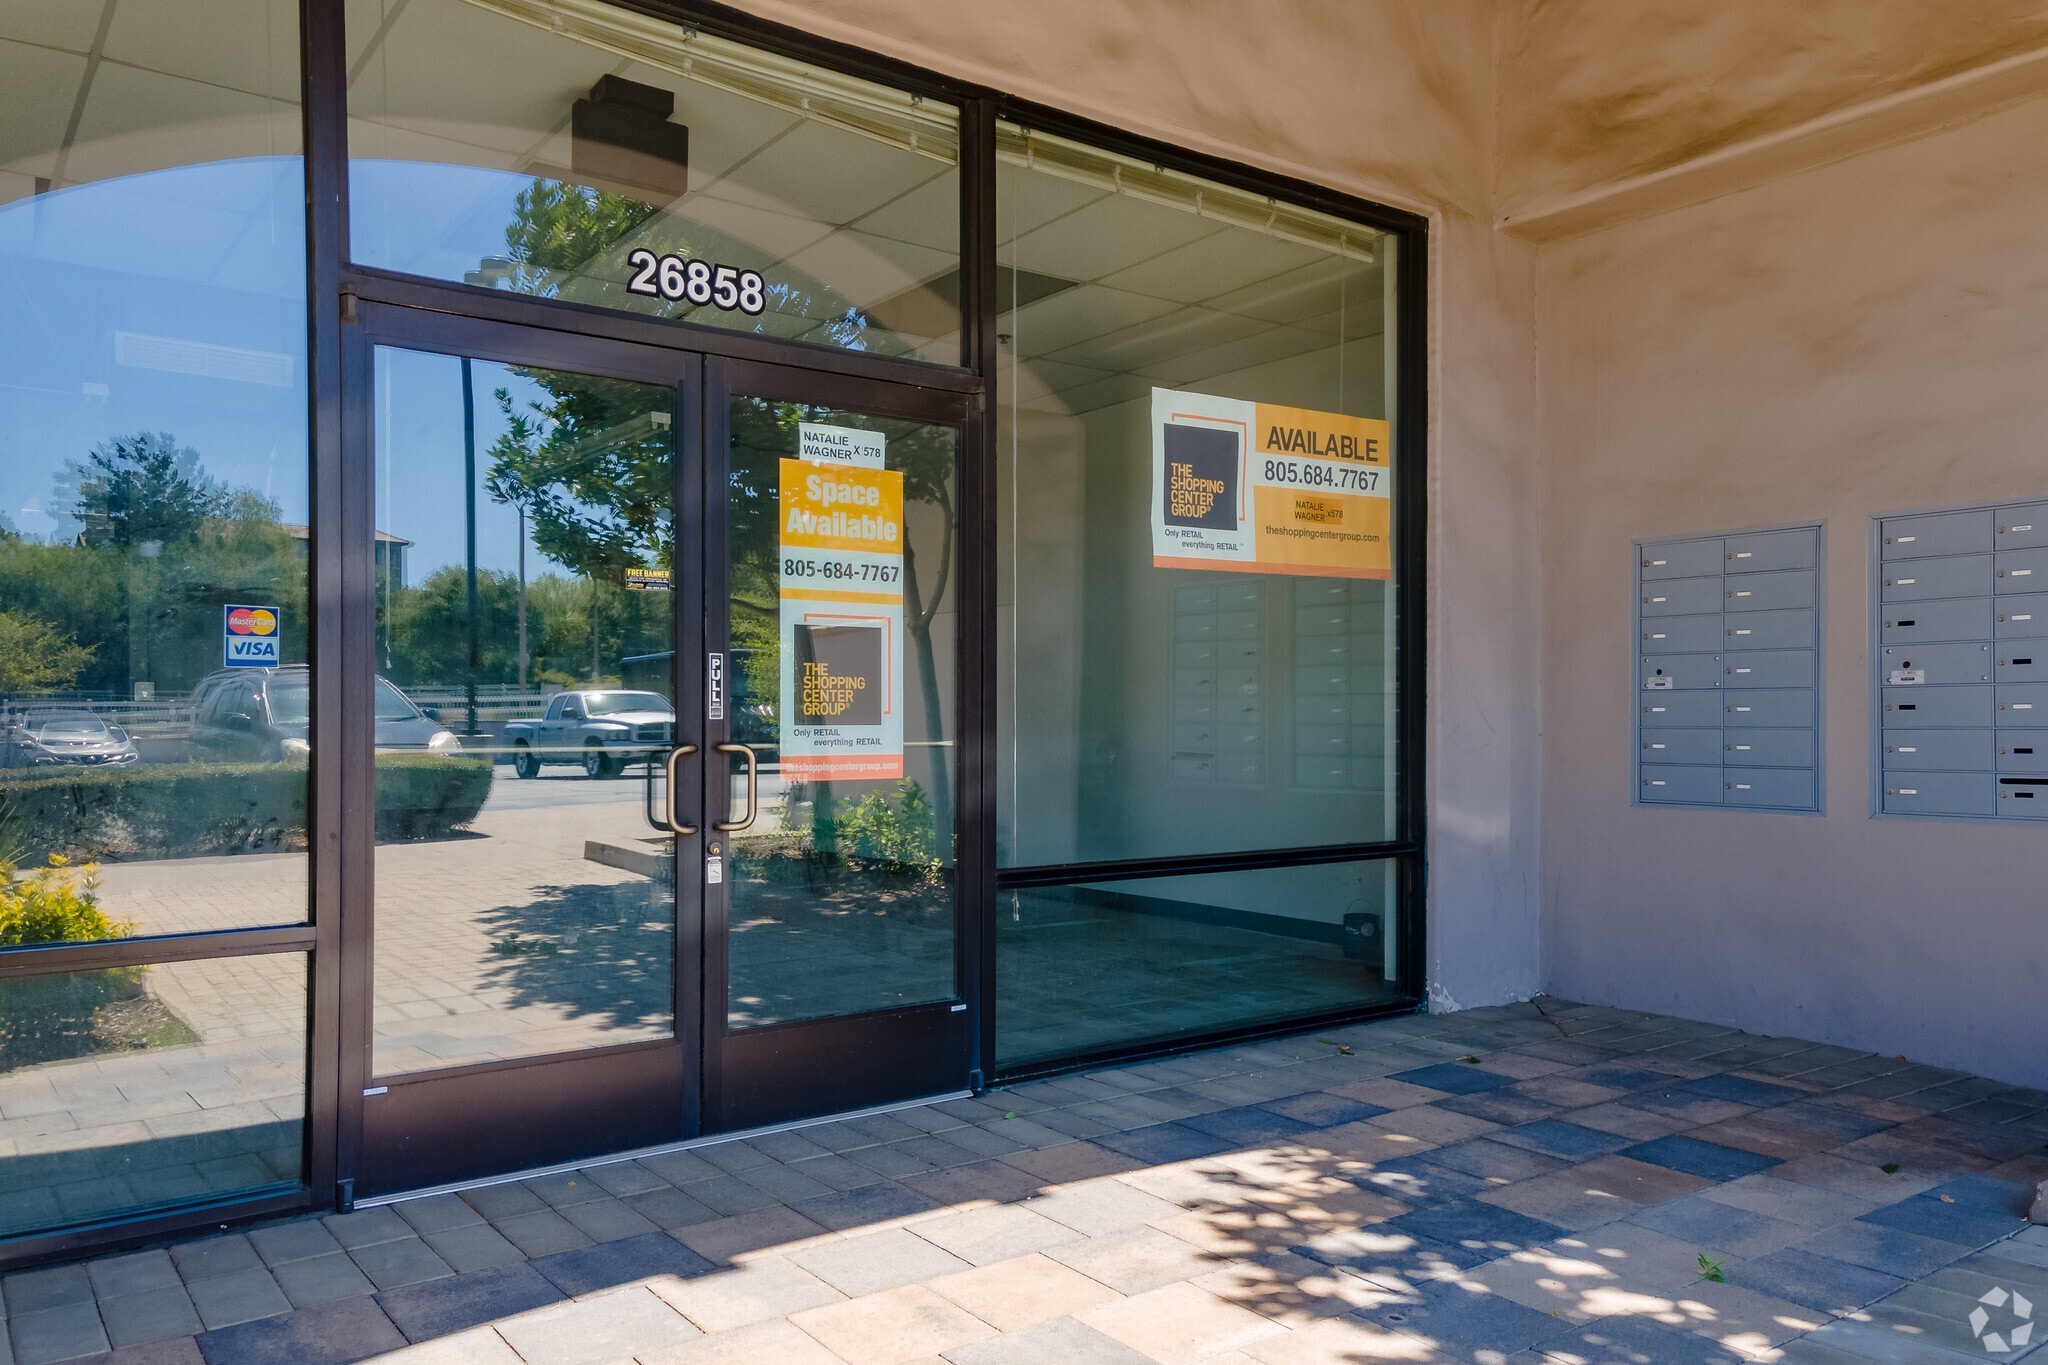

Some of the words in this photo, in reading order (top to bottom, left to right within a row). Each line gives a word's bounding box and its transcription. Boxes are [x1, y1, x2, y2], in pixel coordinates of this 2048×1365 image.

[627, 248, 766, 316] 26858
[803, 431, 849, 446] NATALIE
[1266, 426, 1379, 462] AVAILABLE
[803, 445, 852, 460] WAGNER
[853, 445, 861, 456] X
[863, 447, 881, 458] 578
[1171, 462, 1193, 477] THE
[1264, 460, 1379, 491] 805.684.7767
[806, 474, 880, 507] Space
[1171, 477, 1225, 494] SHOPPING
[1171, 490, 1214, 506] CENTER
[1295, 500, 1324, 511] NATALIE
[1294, 510, 1325, 522] WAGNER
[1326, 510, 1344, 518] x578
[786, 507, 898, 542] Available
[1164, 528, 1179, 539] Only
[1181, 529, 1204, 539] RETAIL
[1265, 525, 1380, 543] theshoppingcentergroup.com
[1181, 540, 1215, 551] everything
[1216, 542, 1239, 551] RETAIL
[627, 569, 643, 577] FREE
[644, 570, 669, 578] BANNER
[784, 558, 900, 583] 805-684-7767
[230, 617, 275, 627] MasterCard
[234, 641, 275, 656] VISA
[803, 662, 829, 676] THE
[711, 658, 721, 702] PULL
[803, 676, 866, 690] SHOPPING
[803, 689, 855, 703] CENTER
[793, 729, 811, 738] Only
[813, 738, 854, 748] everything
[856, 738, 882, 746] RETAIL
[785, 762, 899, 773] theshoppingcentergroup.com
